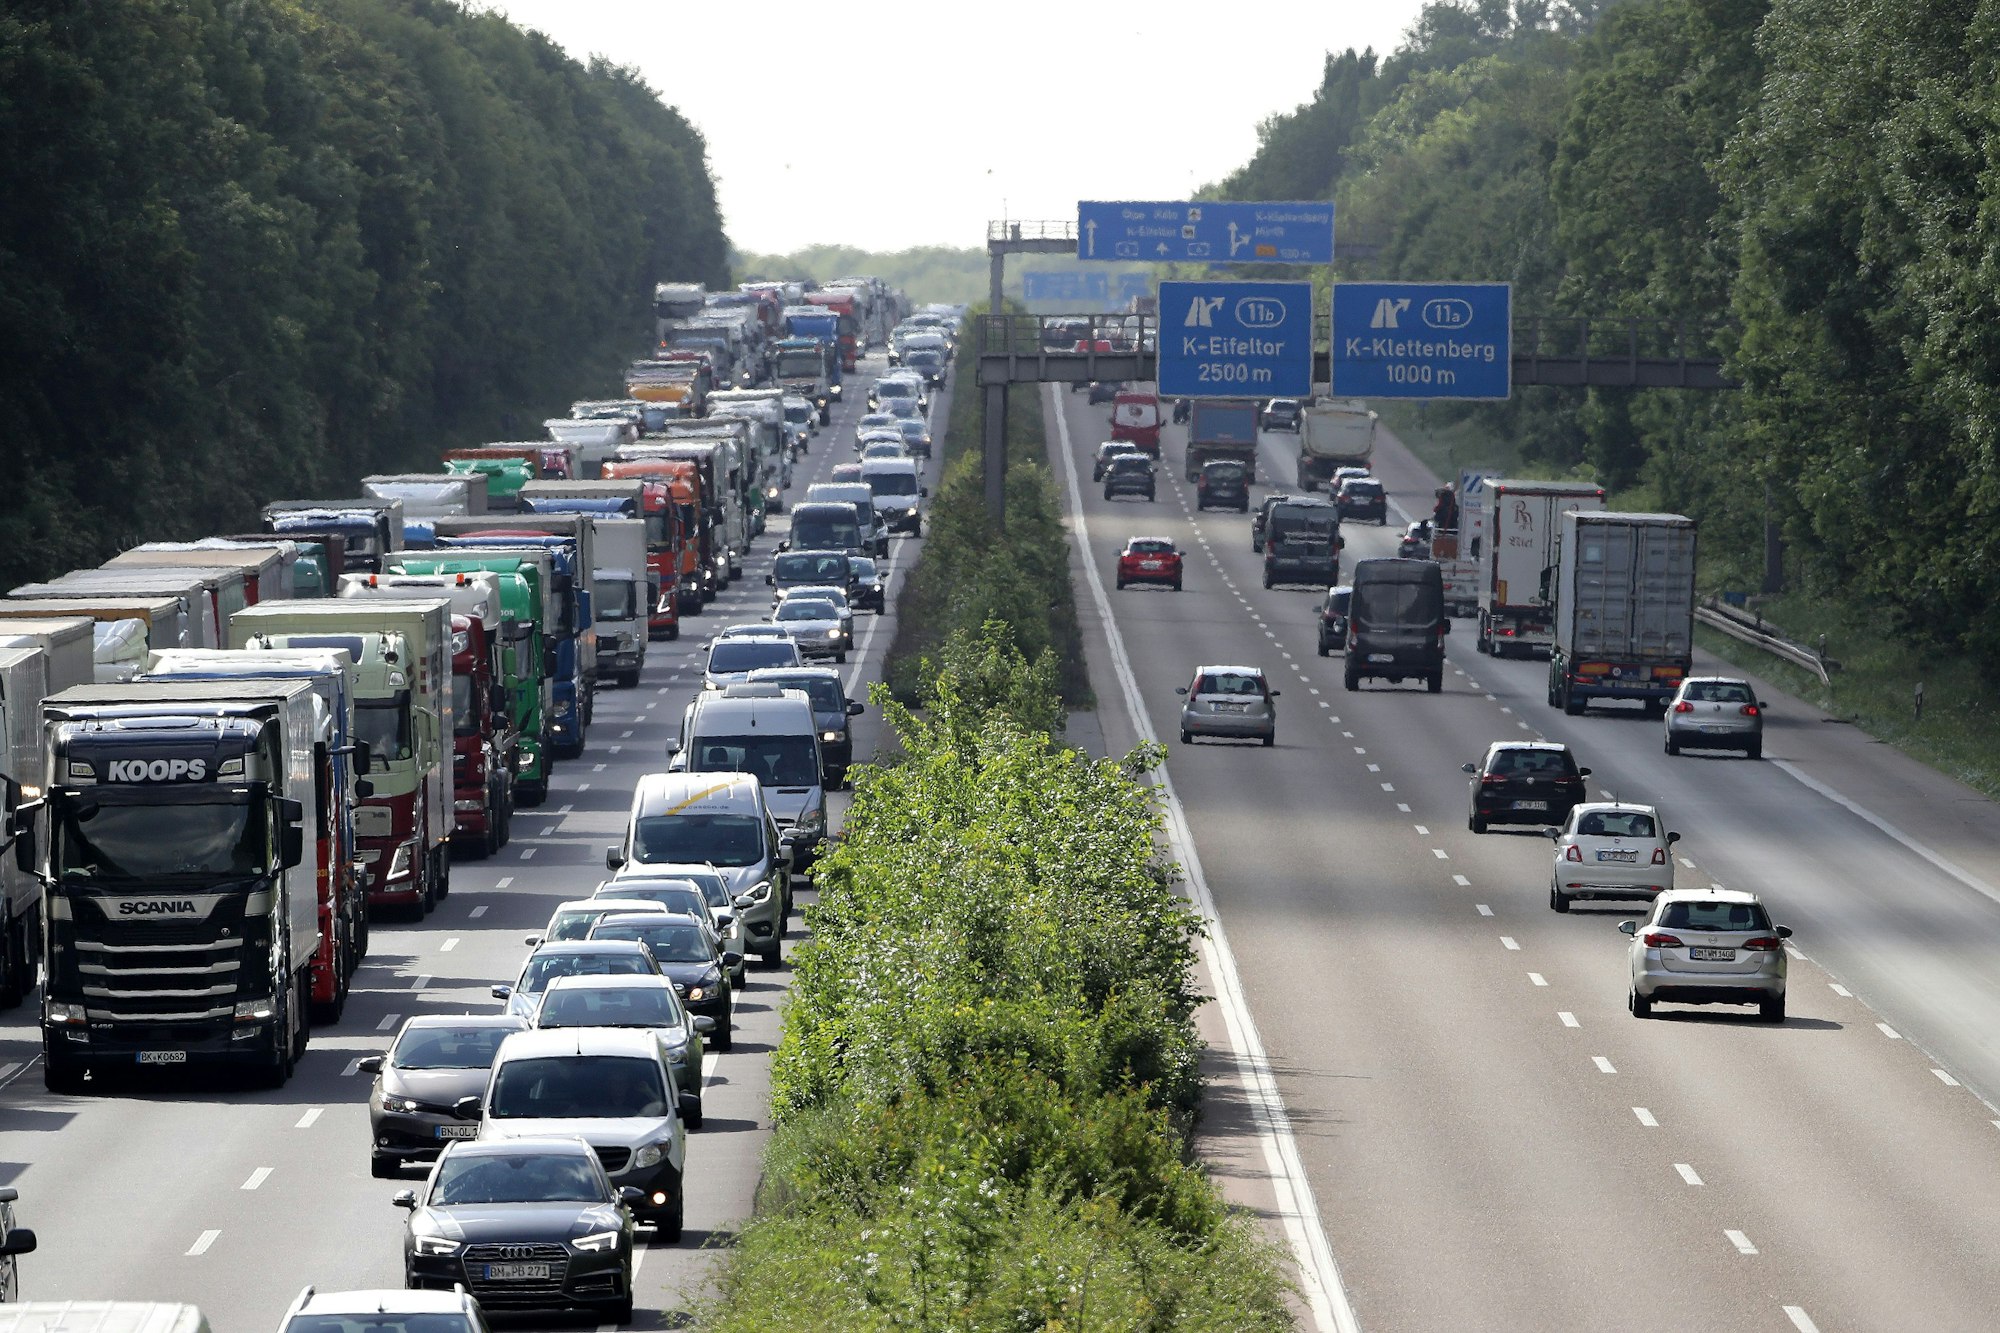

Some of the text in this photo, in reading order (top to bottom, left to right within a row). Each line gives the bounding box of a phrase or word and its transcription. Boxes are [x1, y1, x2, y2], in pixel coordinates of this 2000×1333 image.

[1247, 302, 1275, 322] 11b
[1434, 304, 1461, 323] 11a
[1183, 336, 1286, 357] K-Eifeltor
[1345, 337, 1496, 362] K-Klettenberg
[1198, 363, 1273, 383] 2500 m
[1386, 364, 1456, 385] 1000 m
[107, 758, 206, 782] KOOPS
[119, 901, 197, 915] SCANIA
[527, 1265, 548, 1277] 271
